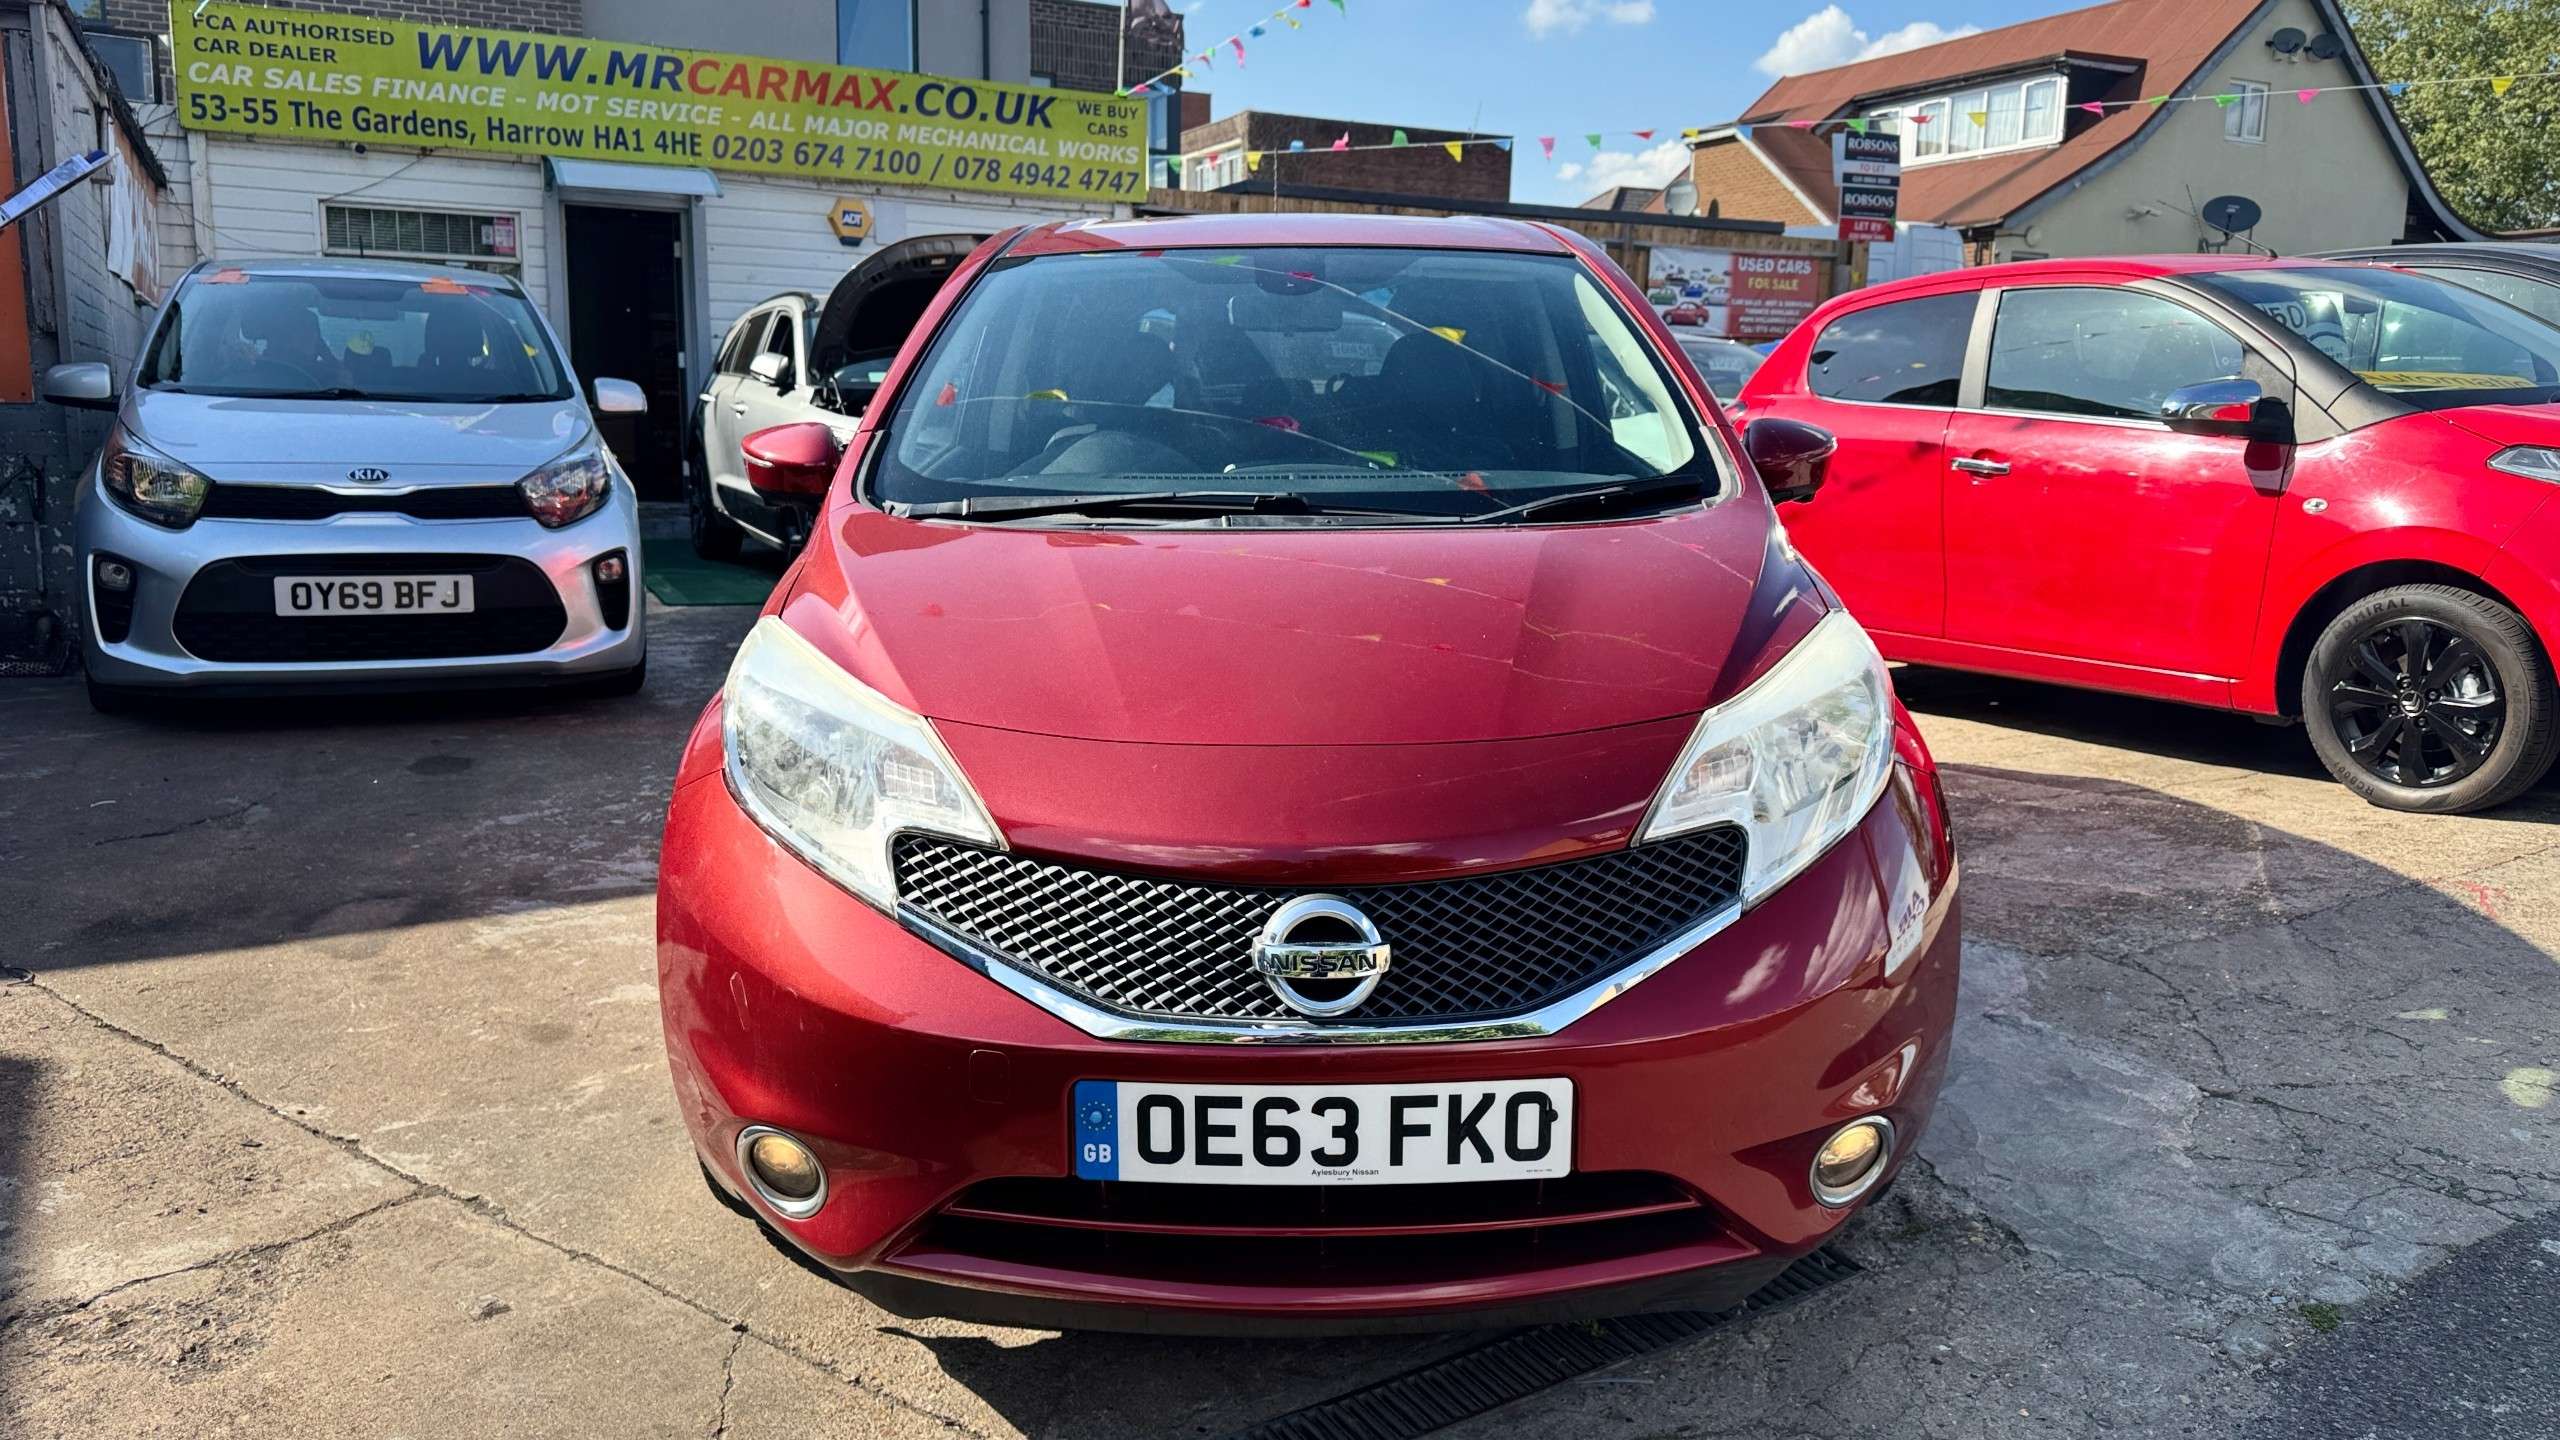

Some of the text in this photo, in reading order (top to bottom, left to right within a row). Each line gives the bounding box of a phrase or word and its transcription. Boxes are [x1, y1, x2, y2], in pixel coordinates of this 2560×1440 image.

[192, 14, 395, 46] FCA AUTHORISED
[193, 36, 338, 63] CAR DEALER
[417, 31, 1057, 129] WWW.MRCARMAX.CO.UK
[188, 62, 254, 87] CAR
[263, 67, 363, 96] SALES
[372, 76, 507, 108] FINANCE
[536, 91, 600, 115] MOT
[605, 97, 724, 125] SERVICE
[748, 110, 796, 133] ALL
[803, 115, 890, 141] MAJOR
[897, 124, 1050, 158] MECHANICAL
[1056, 140, 1140, 165] WORKS
[1077, 101, 1139, 120] WE BUY
[1087, 122, 1129, 138] CARS
[190, 92, 1140, 194] 53-55 The Gardens, Harrow HA1 4HE 0203 674 7100 / 078 4942 4747
[1847, 137, 1898, 153] ROBSONS
[1844, 193, 1895, 208] ROBSONS
[843, 212, 862, 226] ADT
[1854, 221, 1869, 231] LET
[1738, 257, 1812, 274] USED CARS
[1748, 277, 1799, 290] FOR SALE
[354, 468, 385, 480] KIA
[290, 580, 461, 610] OY69 BFJ
[1270, 953, 1377, 972] NISSAN
[1136, 1090, 1552, 1167] OE63 FKO
[1083, 1143, 1112, 1163] GB
[1311, 1169, 1350, 1177] Aylesbury
